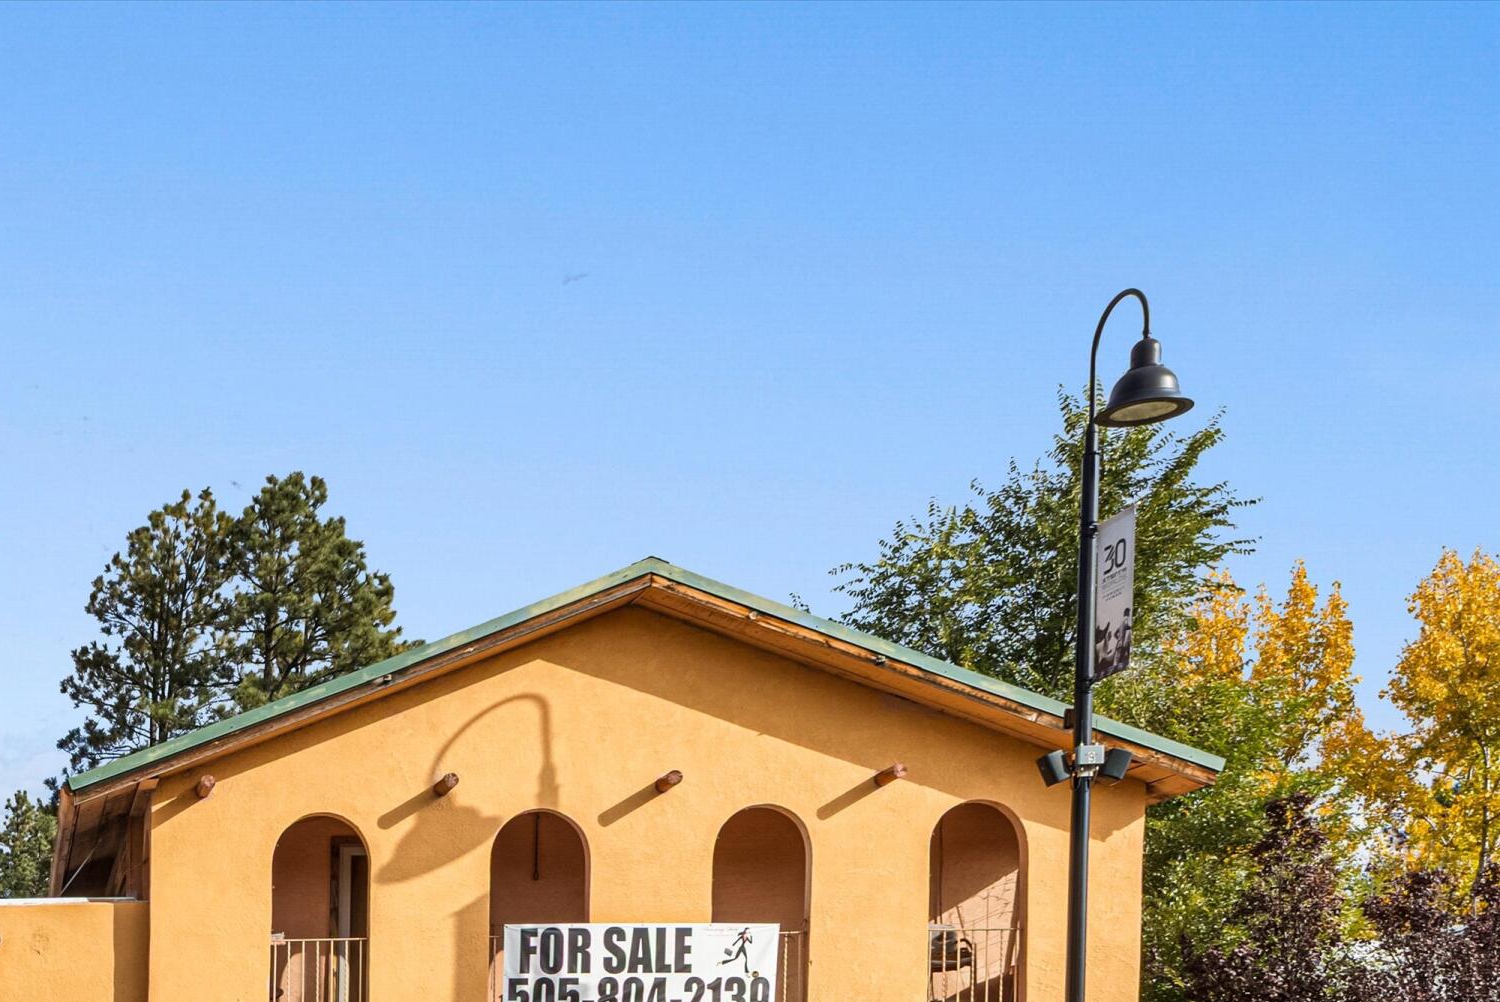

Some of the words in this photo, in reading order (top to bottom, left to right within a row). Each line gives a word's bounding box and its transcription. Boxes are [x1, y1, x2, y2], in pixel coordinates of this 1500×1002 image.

[1103, 538, 1126, 575] 30
[519, 927, 591, 973] FOR
[603, 927, 692, 973] SALE
